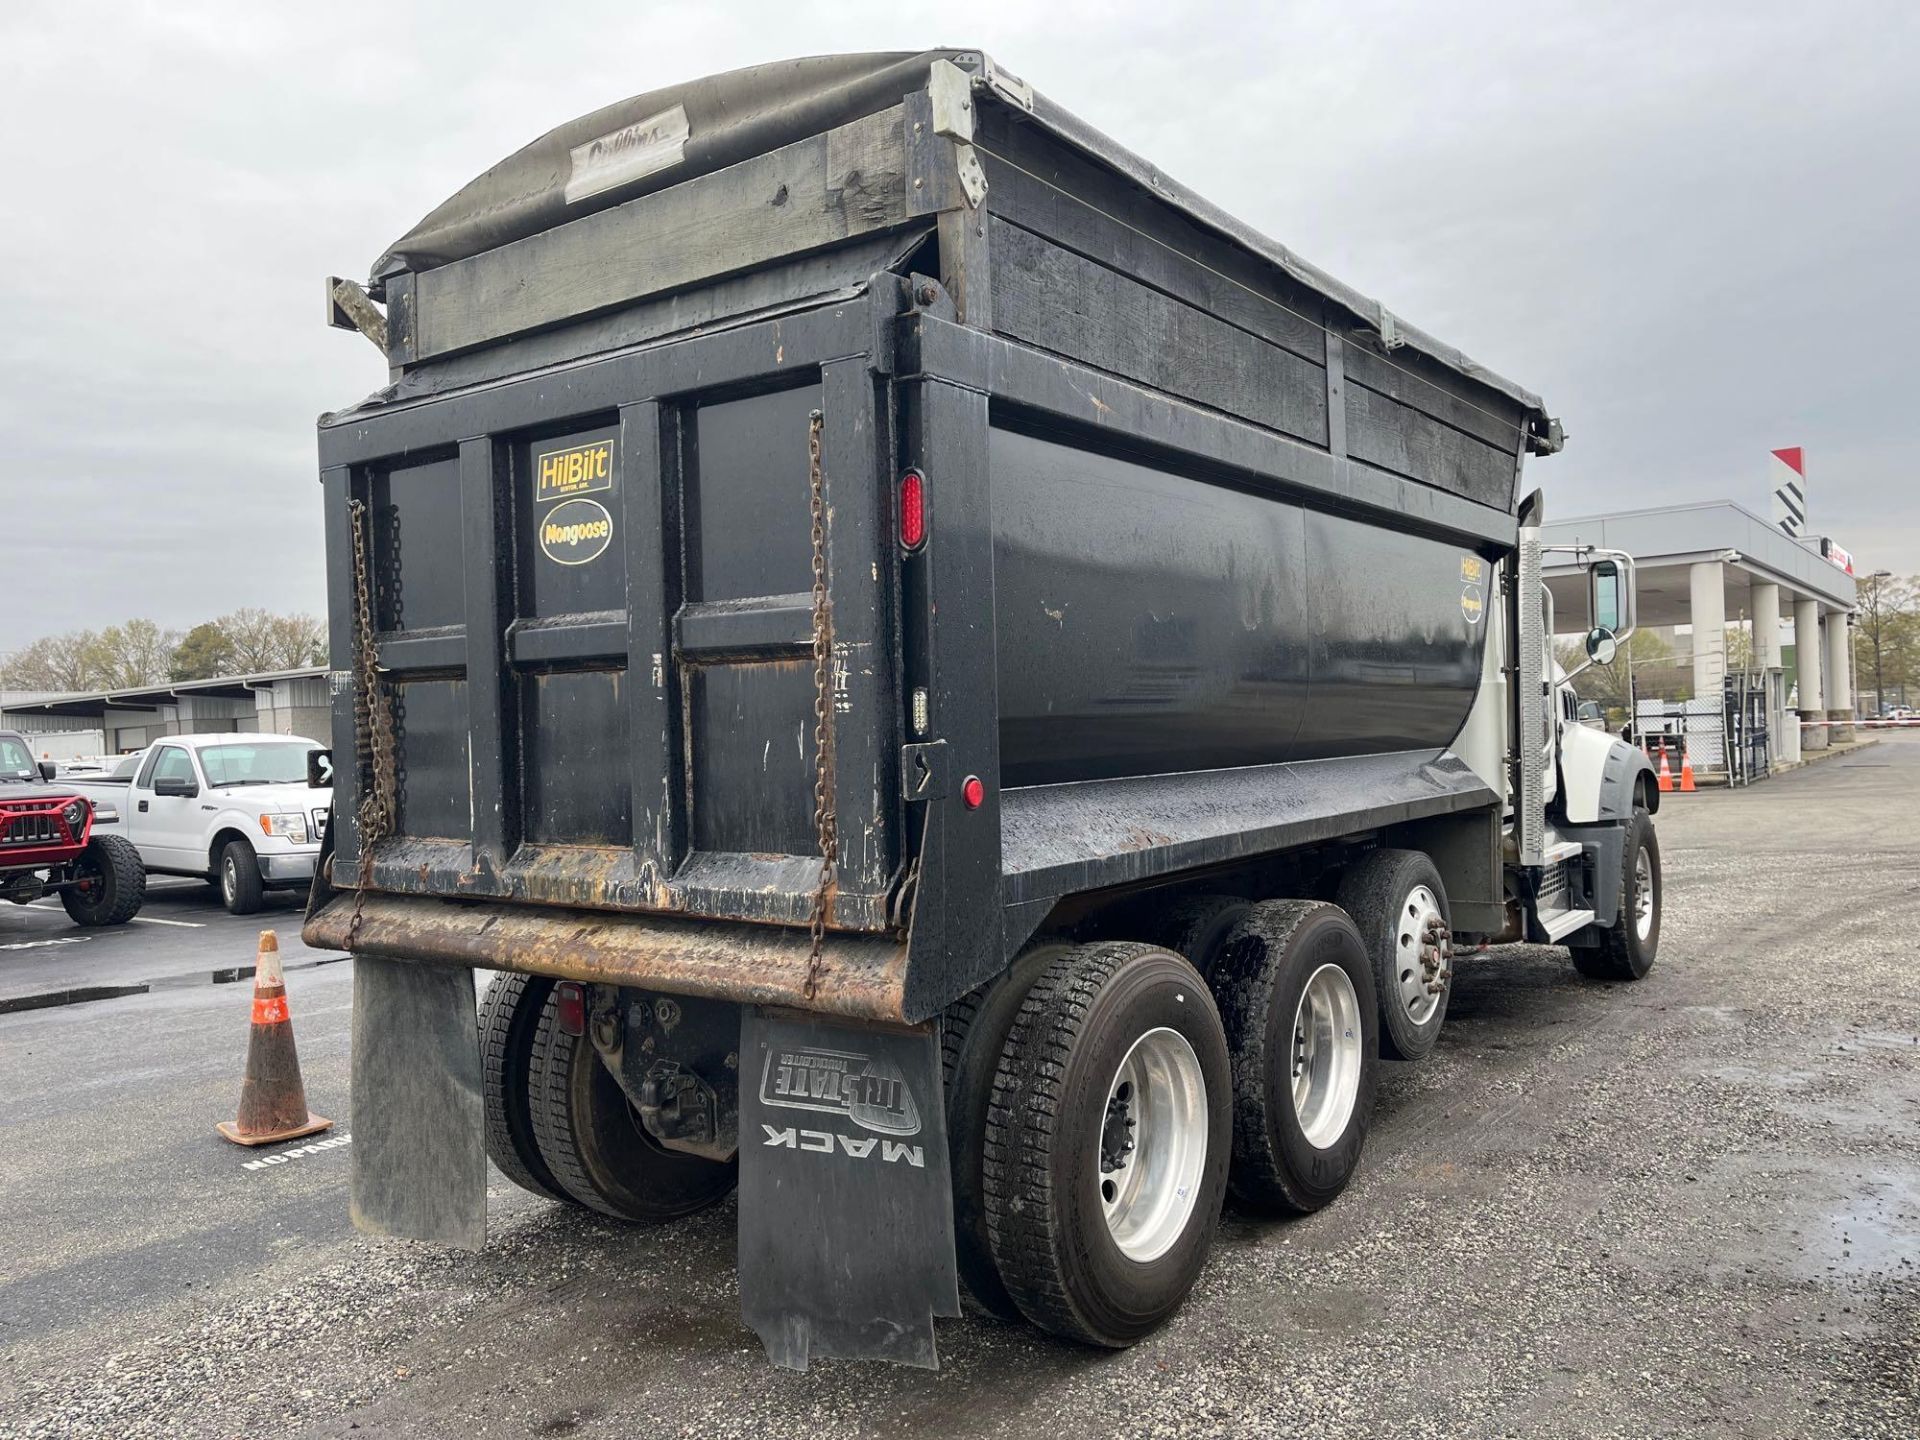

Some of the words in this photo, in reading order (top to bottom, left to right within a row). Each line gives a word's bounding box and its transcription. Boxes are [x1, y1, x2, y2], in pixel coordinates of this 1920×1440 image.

[542, 448, 608, 489] HilBilt
[545, 519, 609, 546] Mongoose
[761, 1124, 925, 1168] MACK
